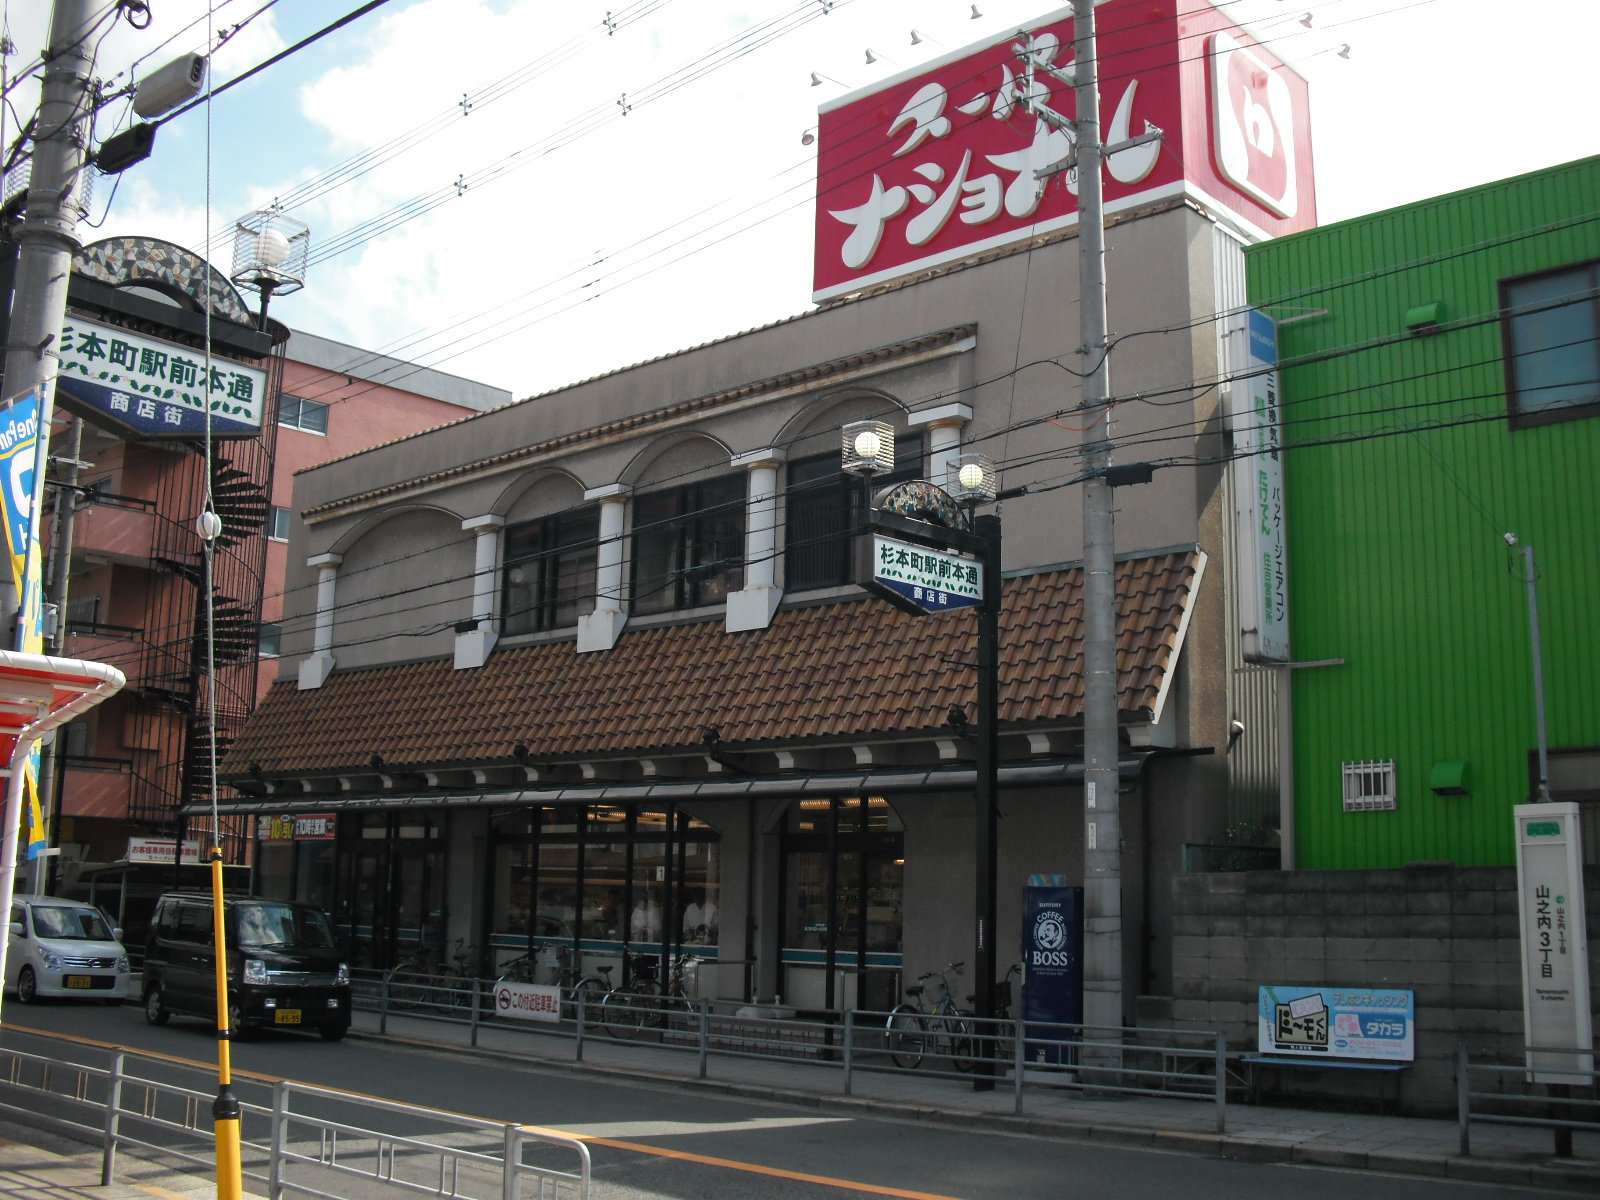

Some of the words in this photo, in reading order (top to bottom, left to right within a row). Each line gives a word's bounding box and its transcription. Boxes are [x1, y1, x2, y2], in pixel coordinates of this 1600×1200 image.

[110, 391, 183, 426] 商店街
[880, 543, 978, 586] 杉本町駅前本通
[913, 586, 948, 605] 商店街
[1036, 911, 1064, 923] COFFEE
[1535, 884, 1553, 979] 山之内3丁目
[1556, 906, 1566, 955] 山之内1丁目
[1032, 950, 1068, 966] BOSS
[1535, 988, 1570, 996] Yamanouchi
[512, 992, 558, 1014] この付近駐車禁止
[1366, 1023, 1404, 1036] タカラ
